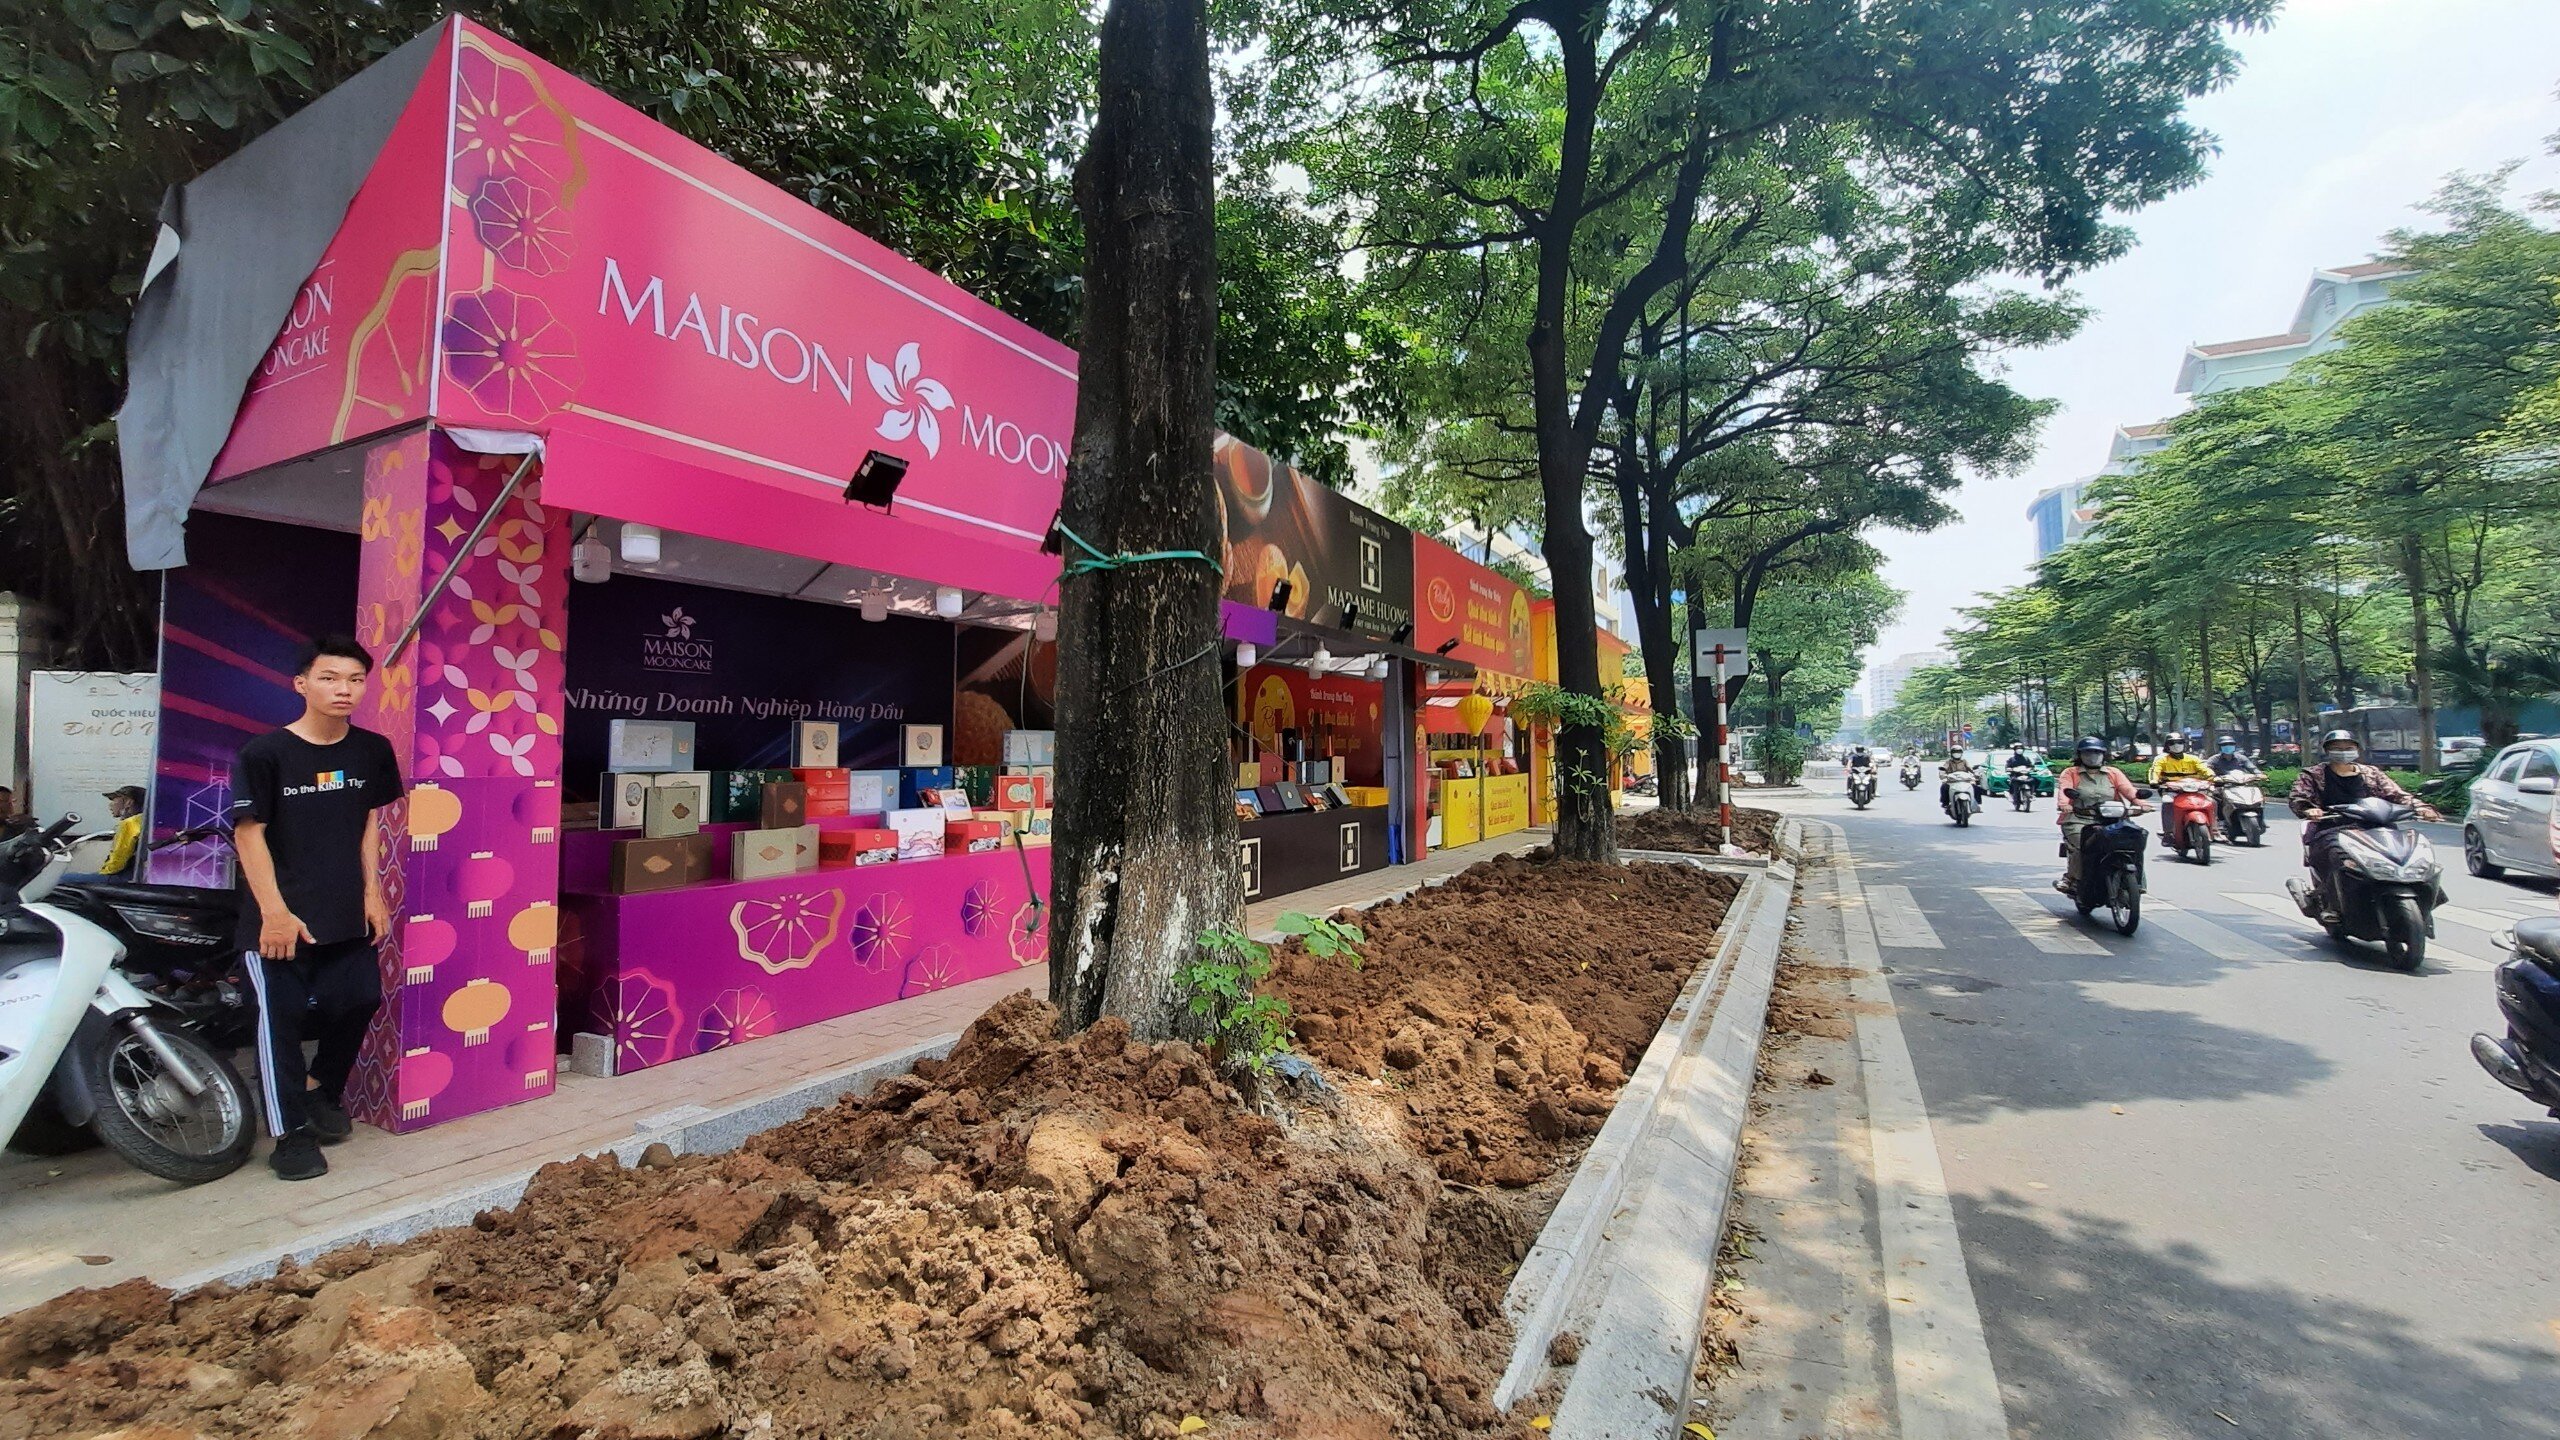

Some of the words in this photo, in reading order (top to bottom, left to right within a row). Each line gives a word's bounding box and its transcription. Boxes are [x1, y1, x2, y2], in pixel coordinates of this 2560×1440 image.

[598, 257, 853, 406] MAISON
[643, 639, 713, 659] MAISON
[643, 655, 713, 671] MOONCAKE
[565, 688, 648, 716] Những
[656, 691, 733, 714] Doanh
[741, 695, 812, 720] Nghiệp
[817, 699, 865, 723] Hàng
[283, 786, 298, 796] Do
[299, 784, 316, 794] the
[318, 781, 344, 792] KIND
